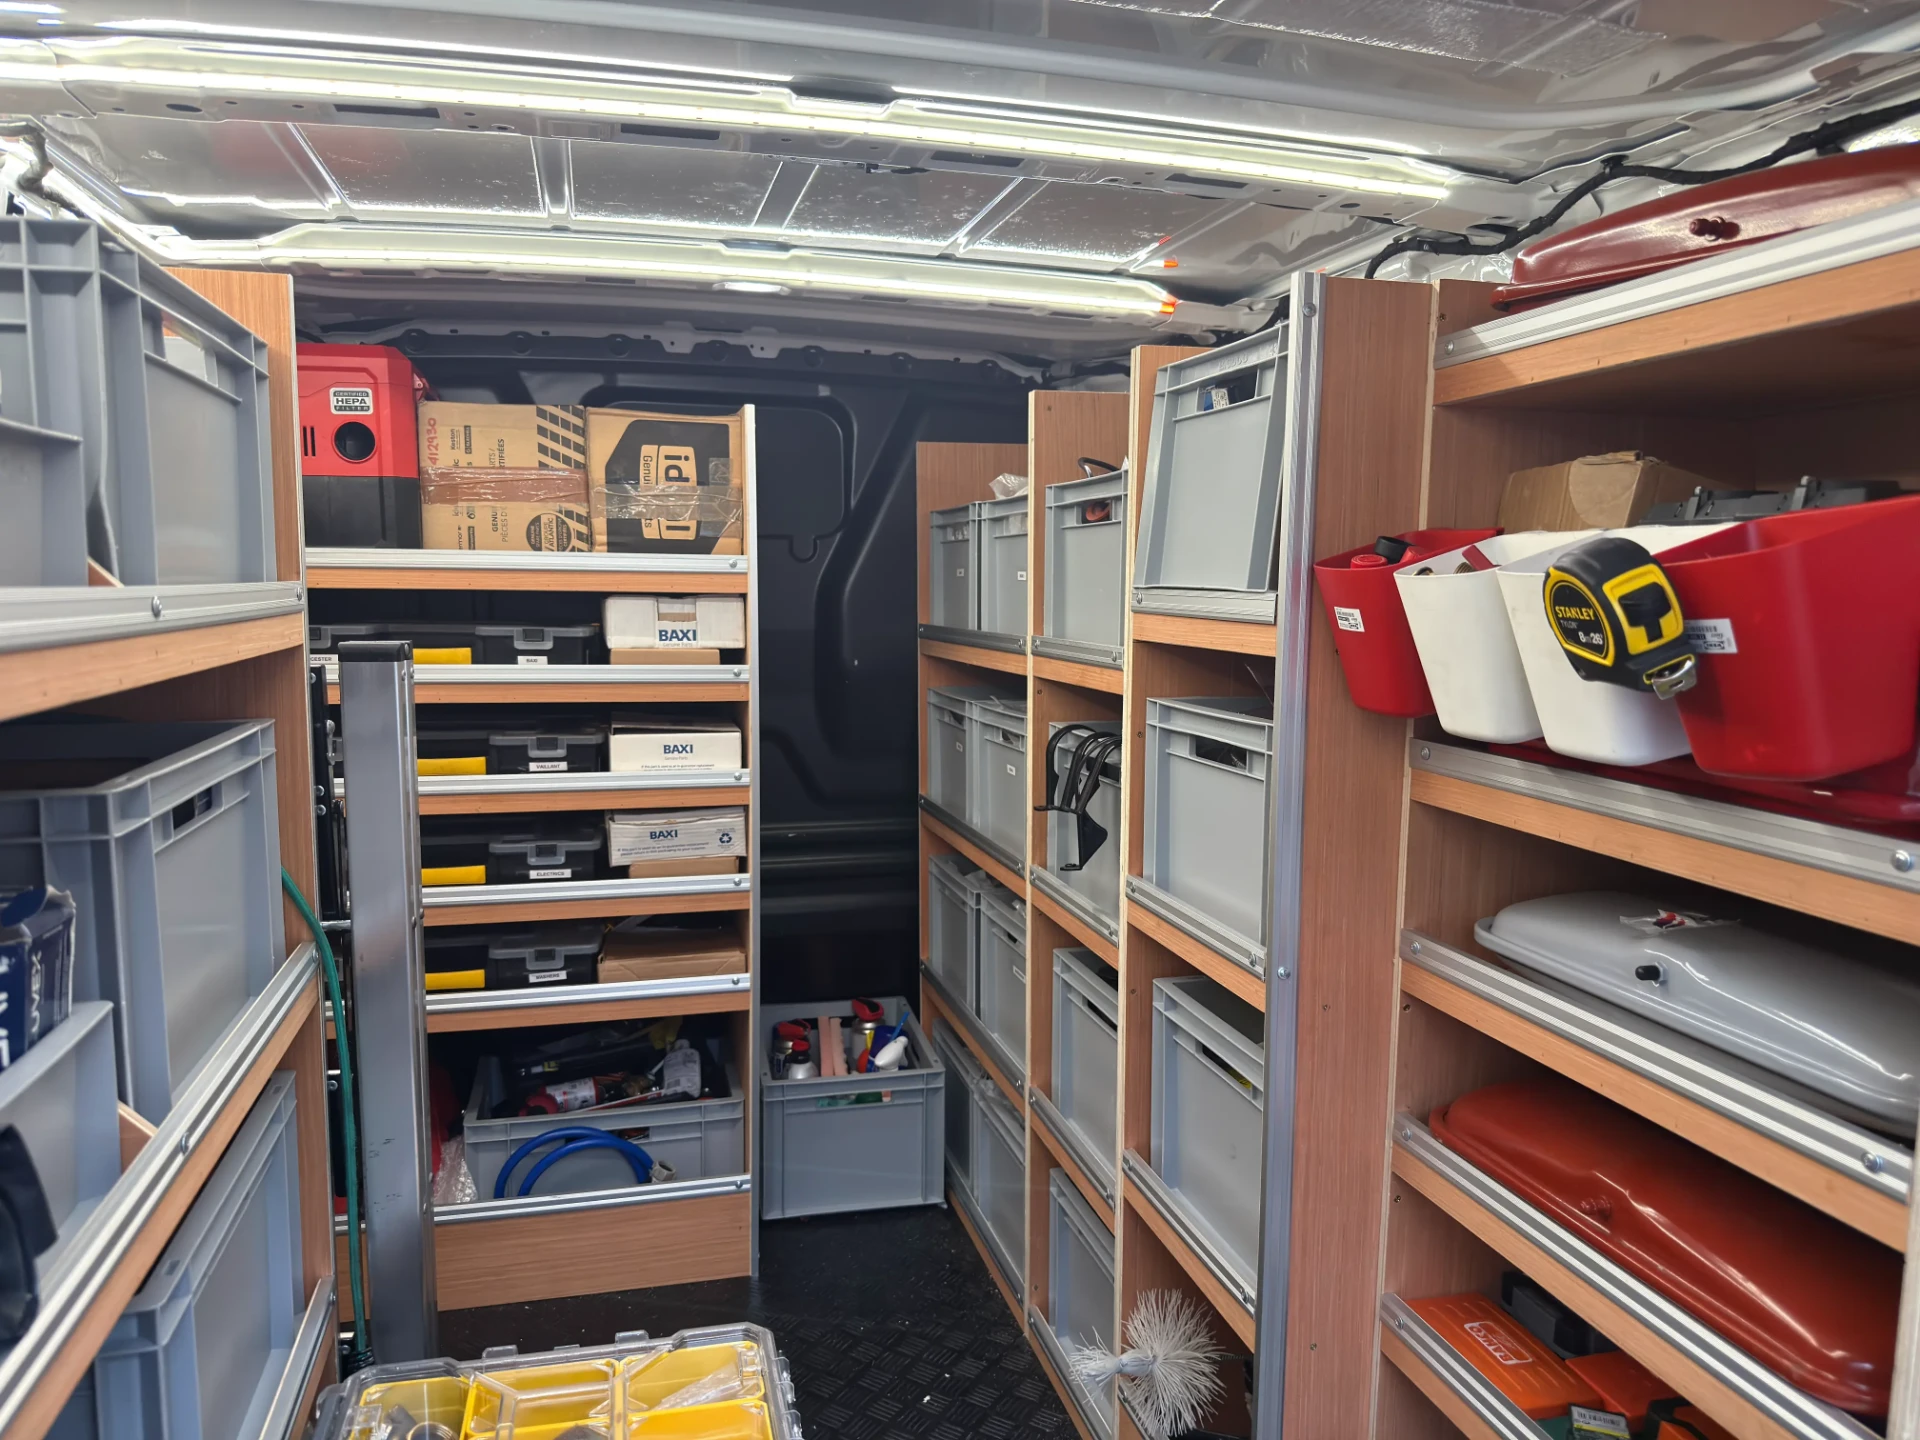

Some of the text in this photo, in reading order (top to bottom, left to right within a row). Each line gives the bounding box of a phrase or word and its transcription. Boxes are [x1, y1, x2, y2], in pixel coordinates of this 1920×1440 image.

[336, 397, 368, 405] HEPA
[426, 417, 440, 466] 412930
[1555, 605, 1595, 620] STANLEY
[658, 629, 697, 642] BAXI
[663, 744, 694, 754] BAXI
[649, 829, 678, 840] BAXI
